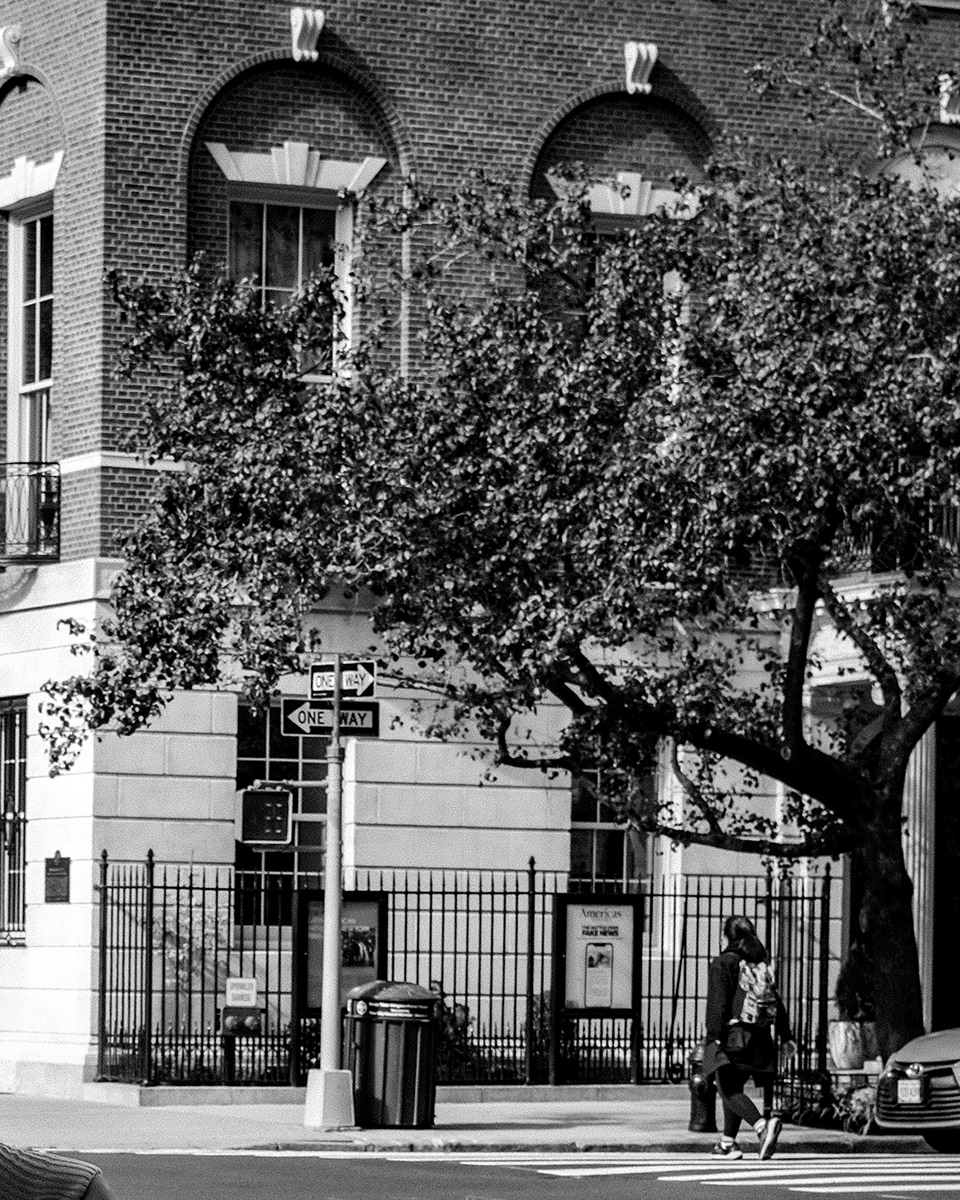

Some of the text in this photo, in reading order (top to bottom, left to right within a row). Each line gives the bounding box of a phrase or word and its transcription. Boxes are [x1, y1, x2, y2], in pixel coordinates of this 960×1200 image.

[315, 673, 367, 689] ONE WAY
[297, 710, 367, 727] ONE WAY
